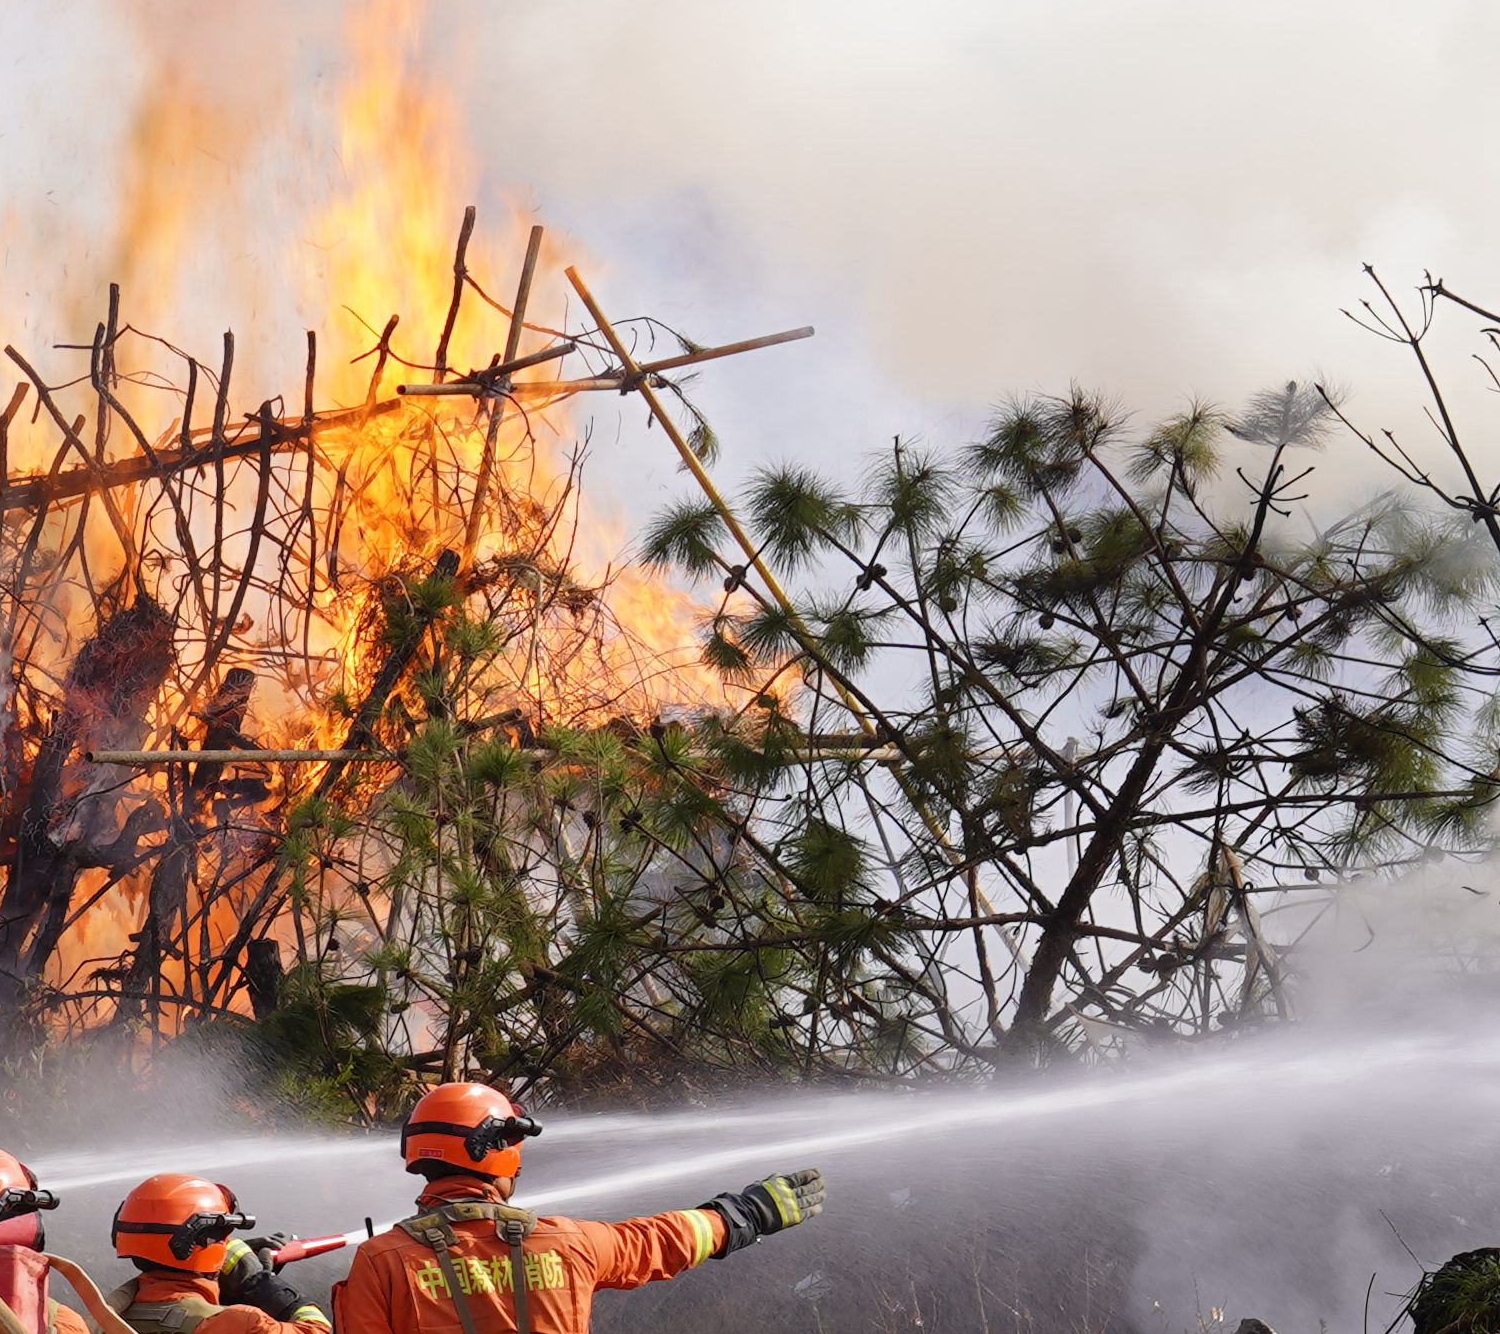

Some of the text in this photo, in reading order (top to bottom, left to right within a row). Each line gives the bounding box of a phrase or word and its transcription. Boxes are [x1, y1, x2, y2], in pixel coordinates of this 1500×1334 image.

[417, 1249, 565, 1299] 中国森林消防
